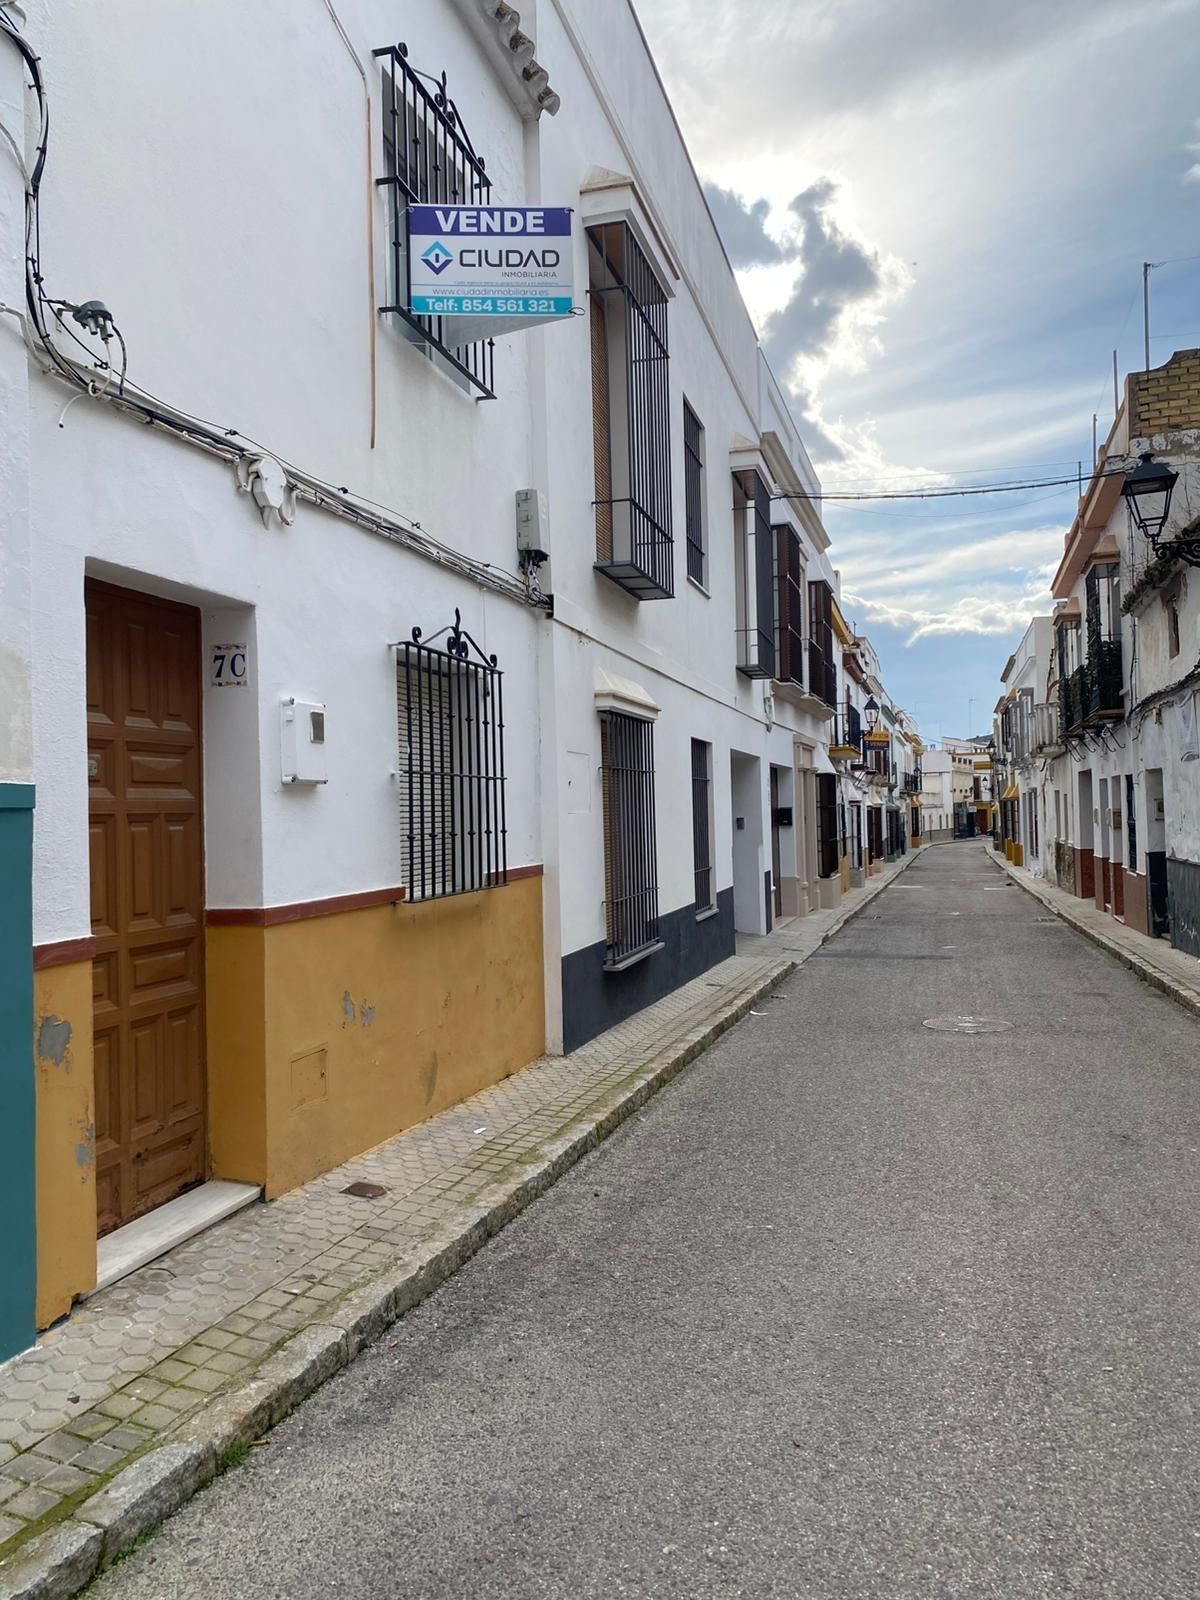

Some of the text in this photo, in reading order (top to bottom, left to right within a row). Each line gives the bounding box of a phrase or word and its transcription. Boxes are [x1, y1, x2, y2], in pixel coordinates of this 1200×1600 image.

[435, 210, 545, 233] VENDE
[459, 249, 560, 268] CIUDAD
[432, 287, 549, 296] www.ciudadinmobiliaria.es
[426, 298, 556, 312] Telf: 854 561 321
[213, 653, 246, 677] 7C
